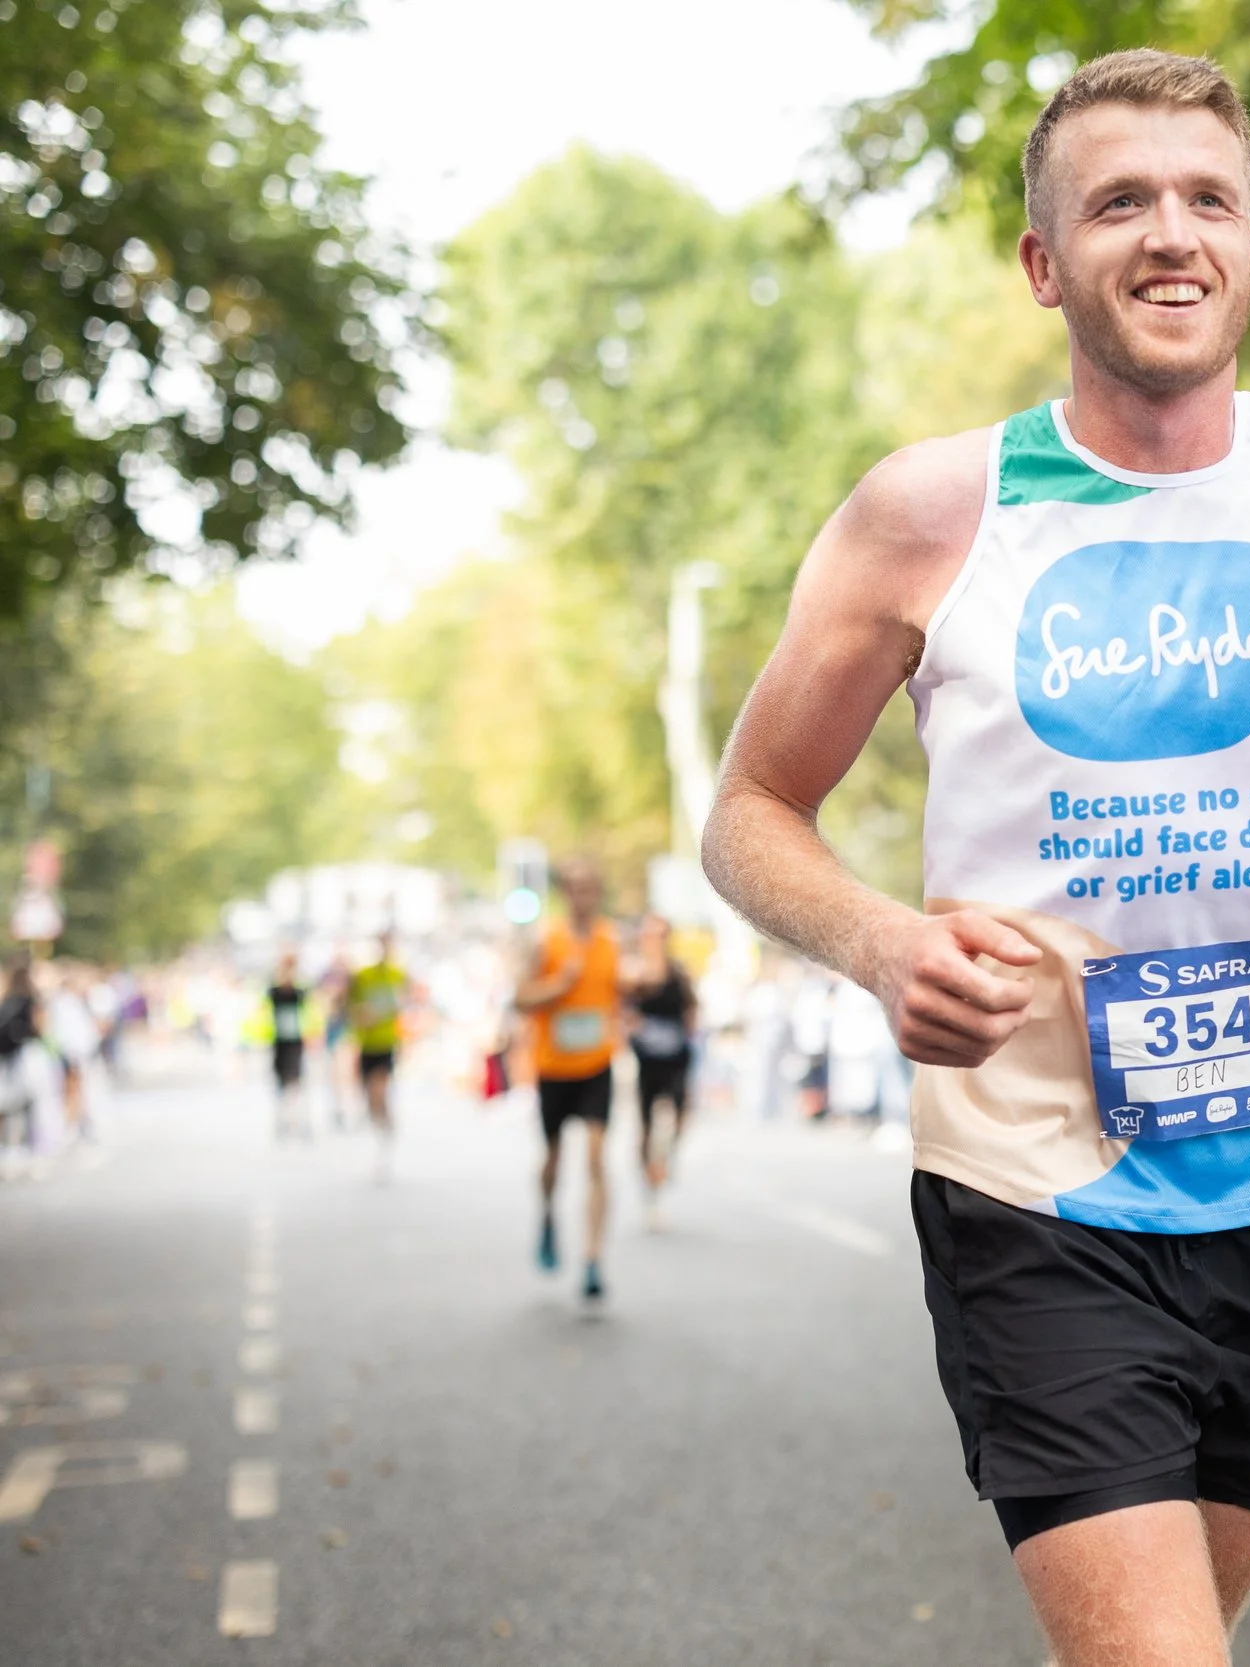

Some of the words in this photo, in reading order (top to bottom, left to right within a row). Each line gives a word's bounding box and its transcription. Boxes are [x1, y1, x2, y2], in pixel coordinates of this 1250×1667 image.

[1040, 602, 1147, 699] Sue
[1050, 790, 1186, 821] Because
[1198, 787, 1240, 812] no
[1039, 827, 1143, 861] should
[1157, 825, 1227, 855] face
[1066, 875, 1105, 899] or
[1116, 863, 1200, 904] grief
[1176, 1059, 1227, 1093] BEN
[1120, 1116, 1137, 1127] XL
[1156, 1110, 1198, 1127] WMP
